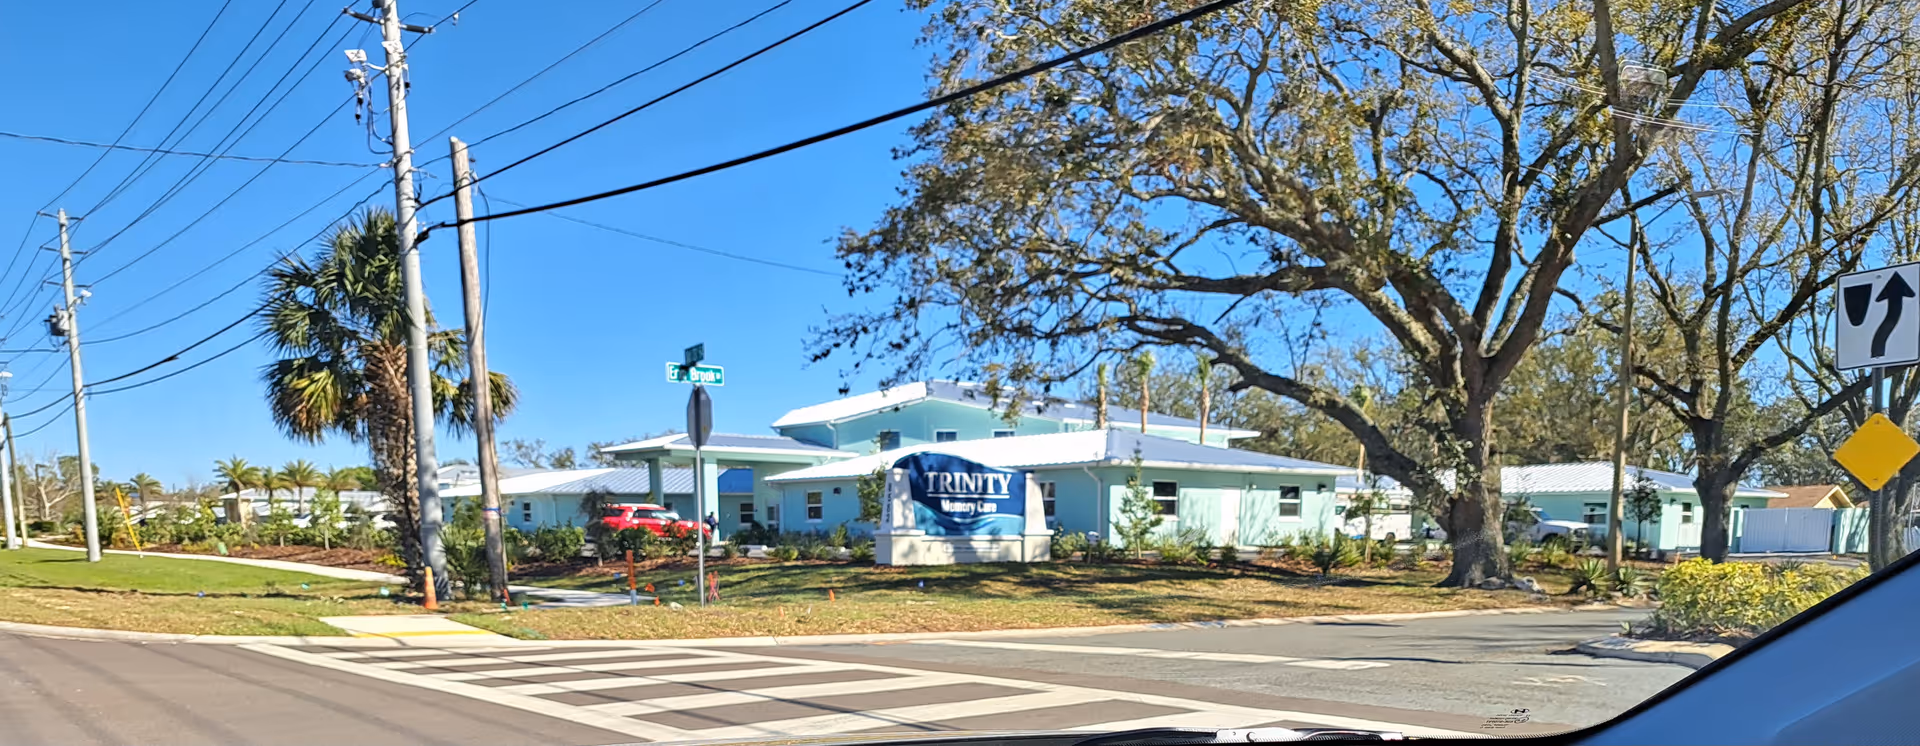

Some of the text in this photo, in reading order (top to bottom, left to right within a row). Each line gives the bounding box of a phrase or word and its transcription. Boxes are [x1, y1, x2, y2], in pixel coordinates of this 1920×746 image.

[690, 366, 715, 382] Brook
[924, 472, 1012, 494] TRINITY
[941, 498, 997, 515] Memory Care
